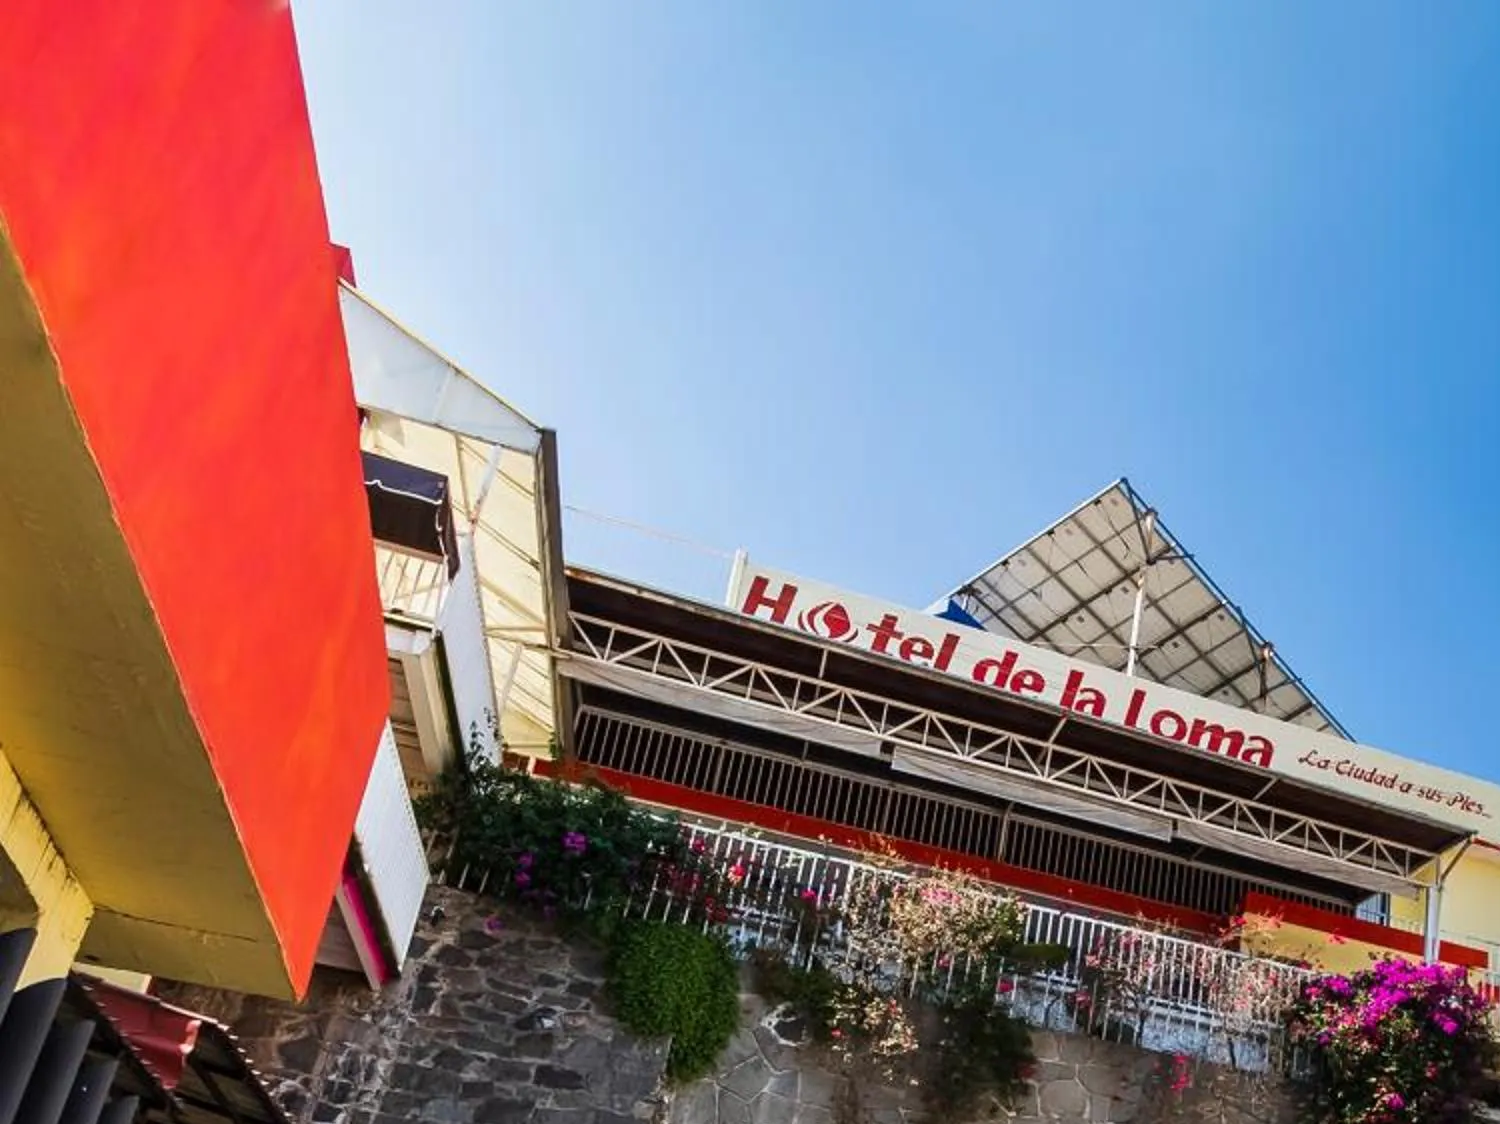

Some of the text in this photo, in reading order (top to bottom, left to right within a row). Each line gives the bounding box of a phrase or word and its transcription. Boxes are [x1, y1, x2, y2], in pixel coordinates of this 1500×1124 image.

[971, 650, 1046, 695] de
[1059, 669, 1107, 719] la
[1298, 750, 1331, 770] La
[1335, 759, 1399, 790] Ciudad
[1399, 782, 1414, 794] a
[1417, 786, 1442, 804] sus
